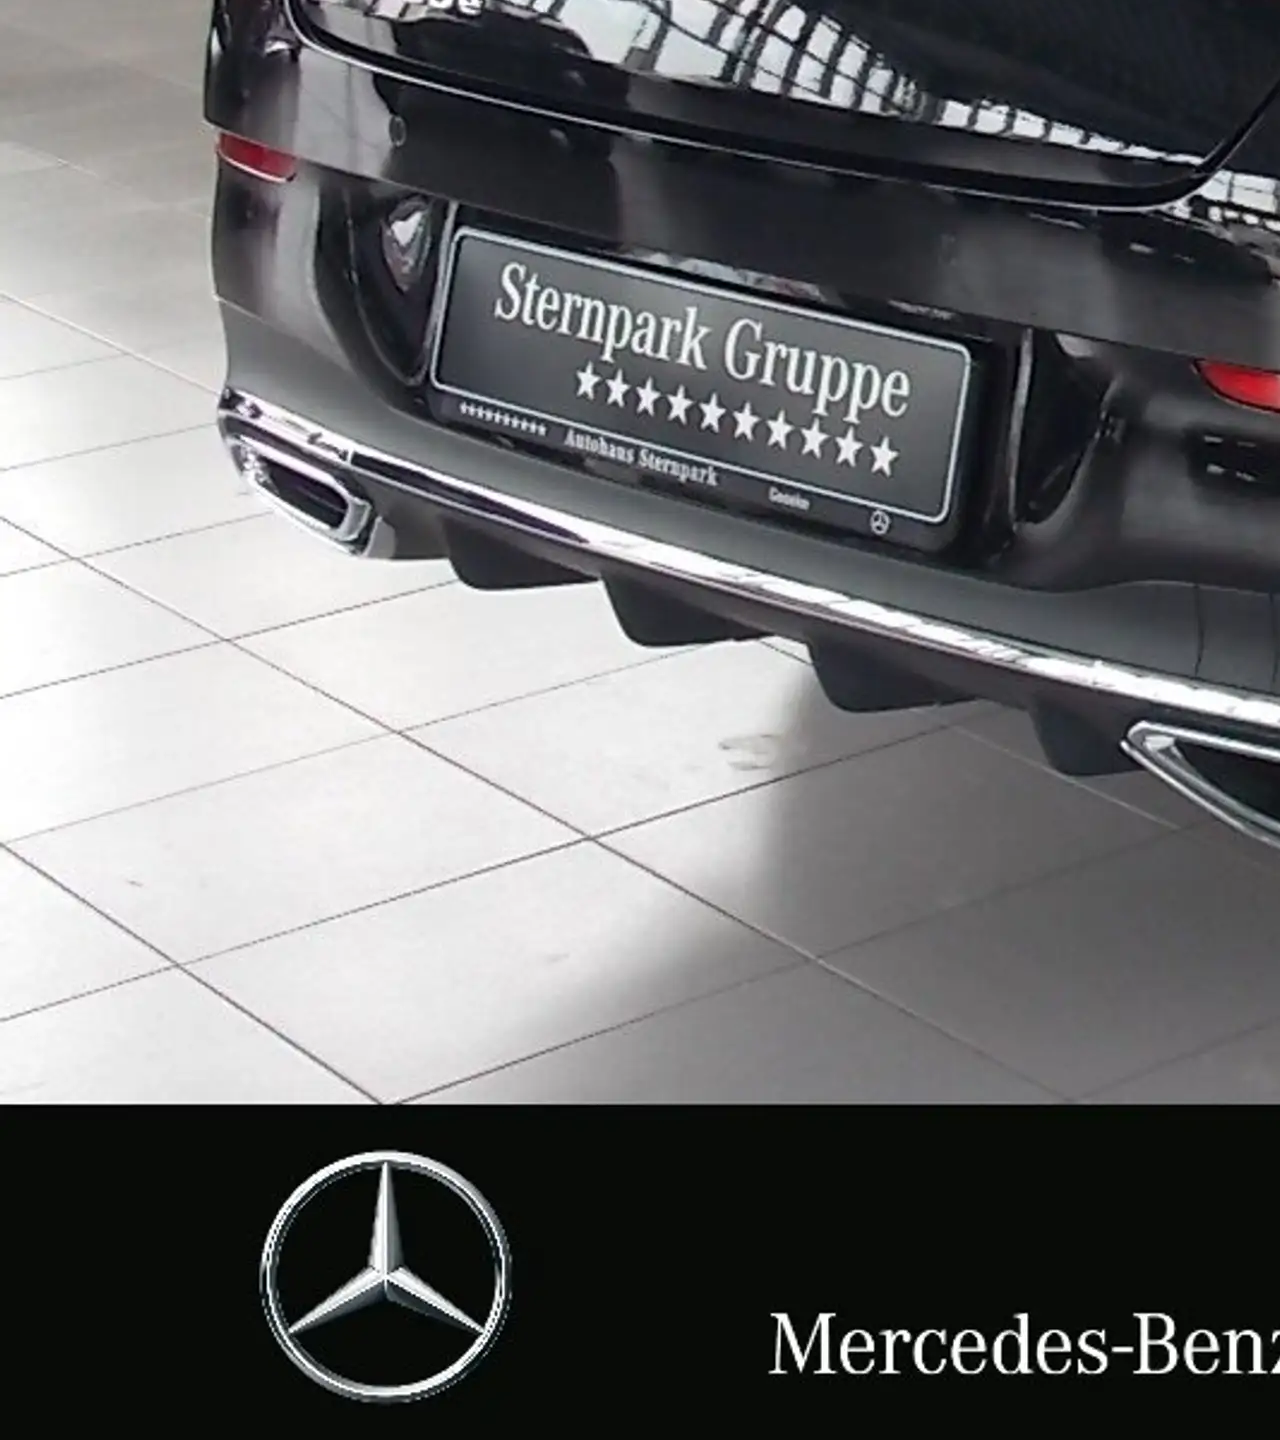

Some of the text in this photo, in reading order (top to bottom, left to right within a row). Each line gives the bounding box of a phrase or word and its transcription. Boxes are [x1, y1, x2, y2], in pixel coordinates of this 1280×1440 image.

[494, 261, 911, 424] Sternpark Gruppe
[563, 428, 719, 488] Autohaus Sternpark
